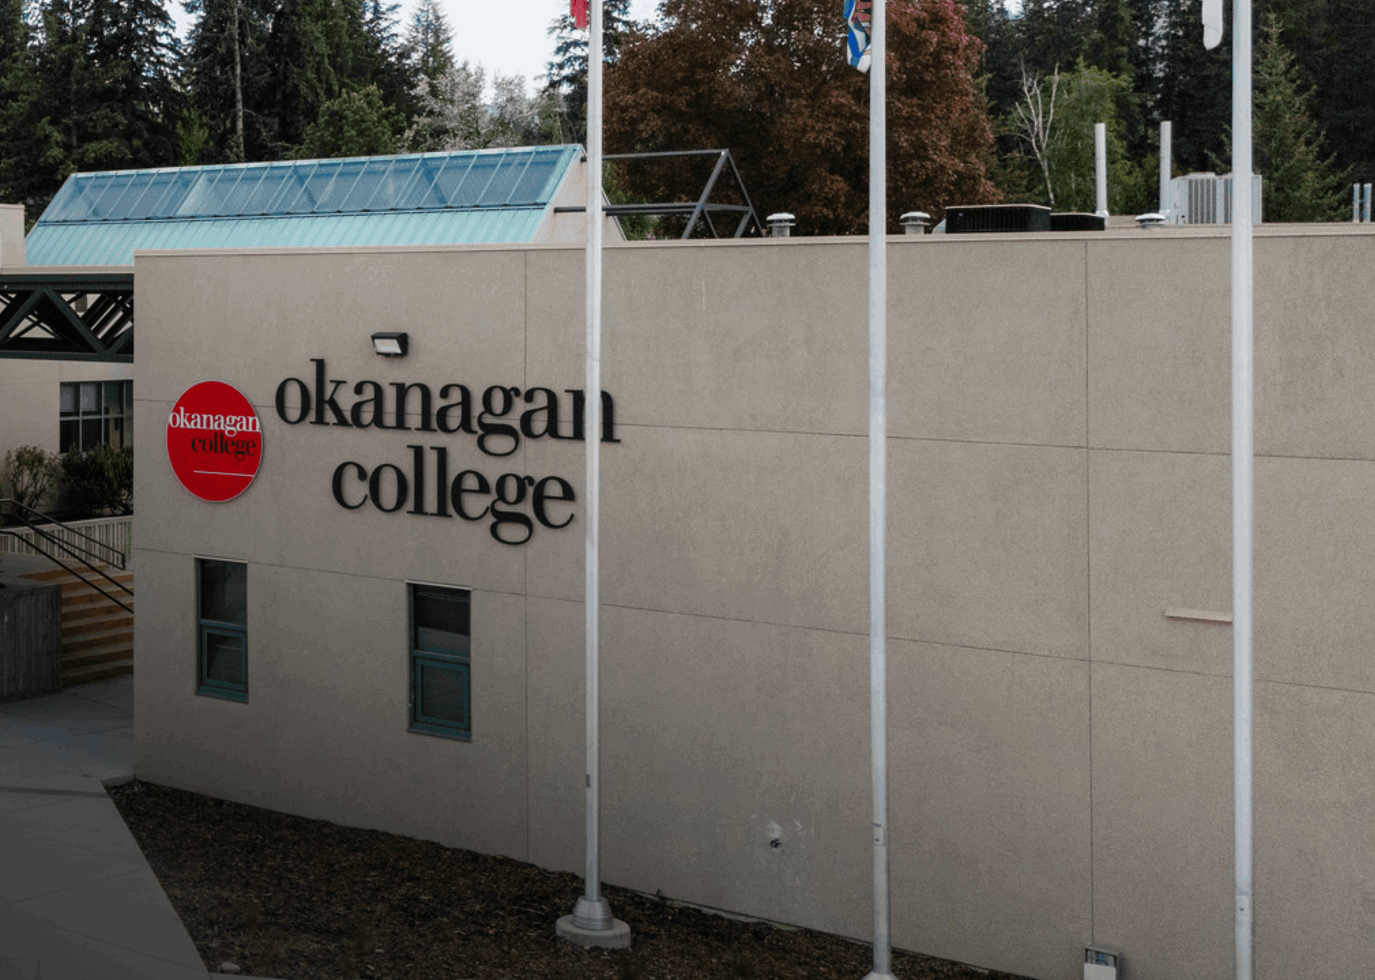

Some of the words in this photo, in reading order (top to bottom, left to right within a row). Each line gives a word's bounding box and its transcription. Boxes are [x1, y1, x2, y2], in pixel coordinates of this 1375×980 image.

[169, 406, 261, 437] okanagan
[274, 358, 622, 457] okanagan
[191, 432, 256, 461] college
[331, 444, 575, 546] college
